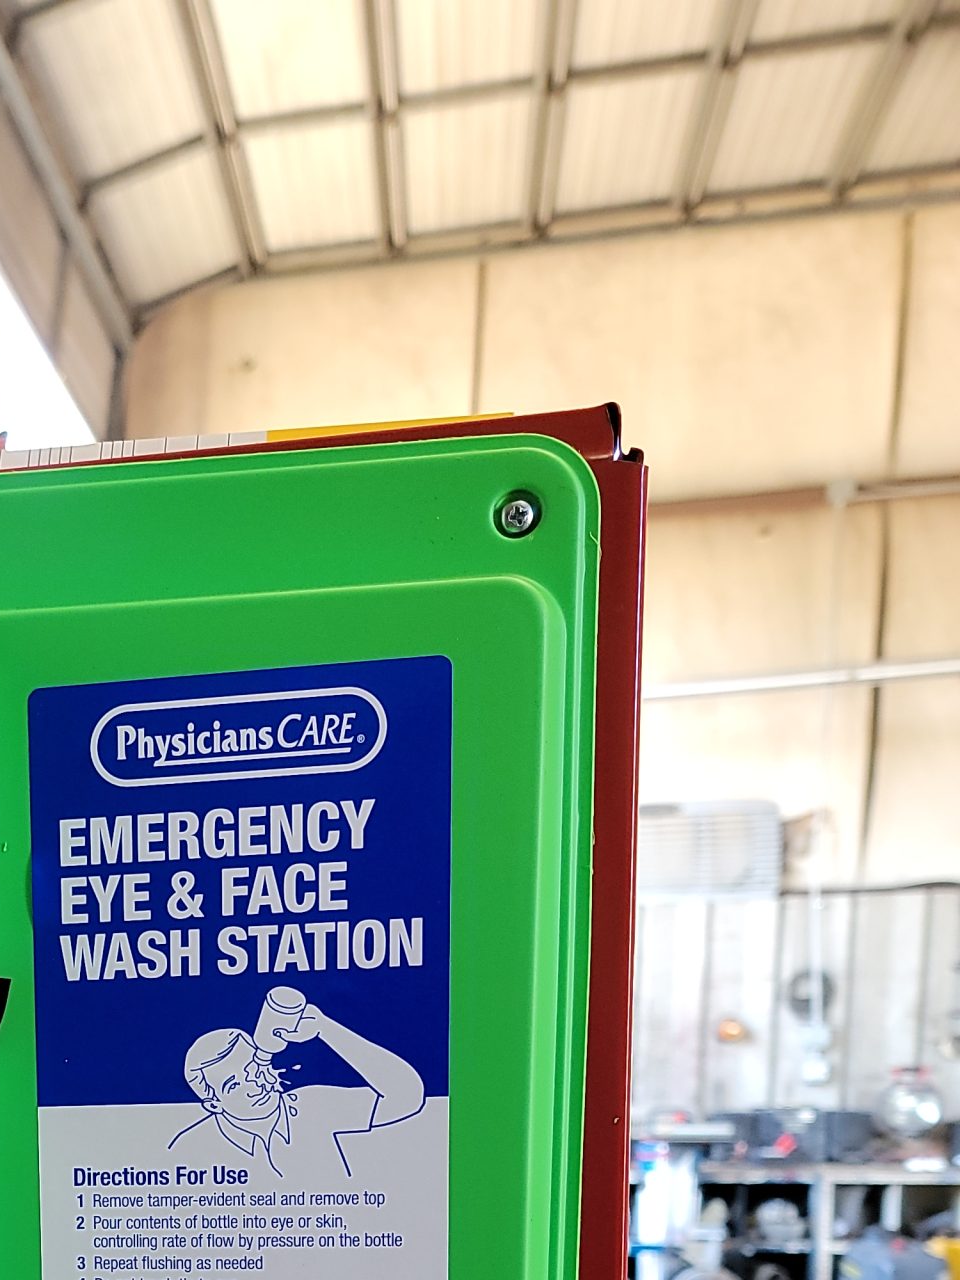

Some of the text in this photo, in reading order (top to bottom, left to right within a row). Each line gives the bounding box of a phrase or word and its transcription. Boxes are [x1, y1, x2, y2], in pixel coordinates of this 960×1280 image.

[59, 798, 376, 867] EMERGENCY
[59, 861, 348, 924] EYE & FACE
[59, 917, 424, 982] WASH STATION
[73, 1165, 249, 1187] Directions For Use
[76, 1191, 386, 1210] 1 Remove tamper-evident seal and remove top
[76, 1214, 347, 1232] 2 Pour contents of bottle into eye or skin,
[93, 1232, 403, 1251] controlling rate of flow by pressure on the bottle
[77, 1255, 263, 1273] 3 Repeat flushing as needed
